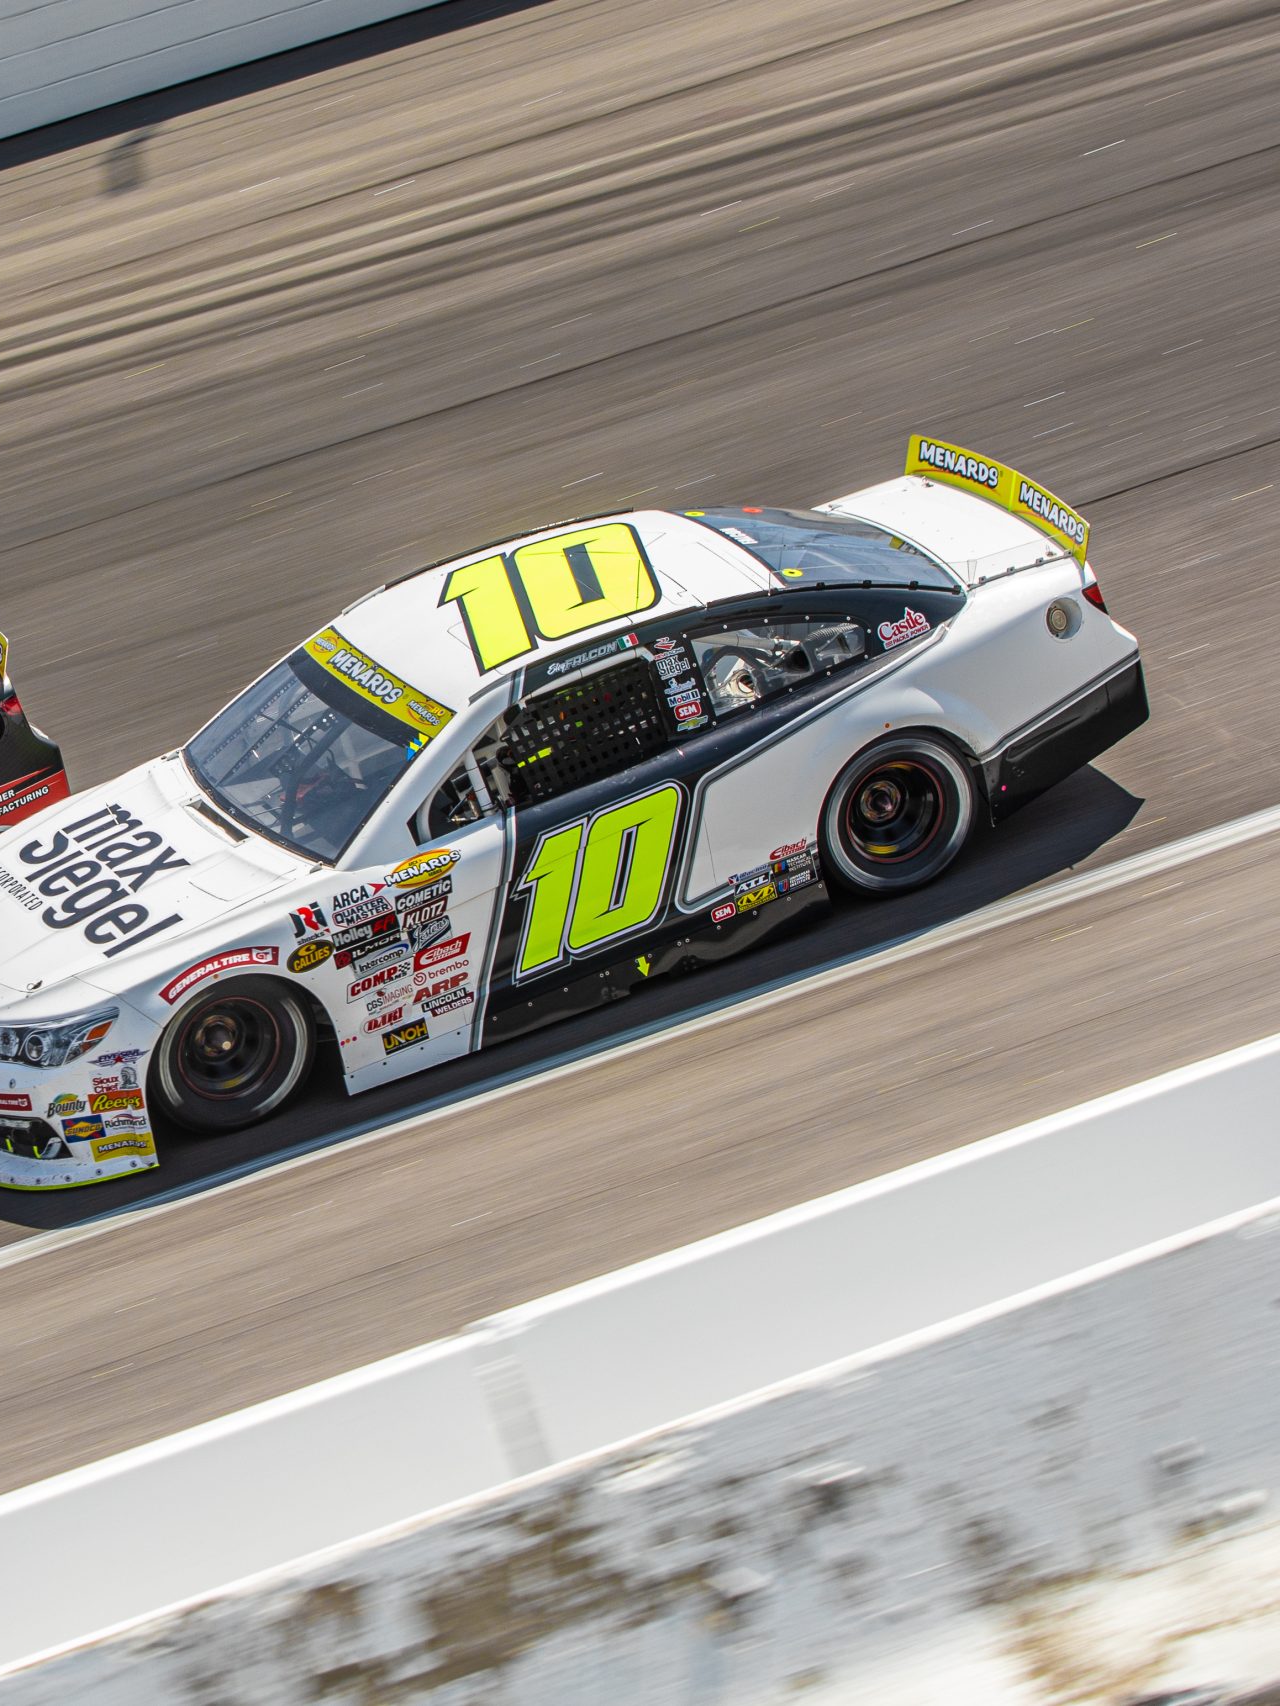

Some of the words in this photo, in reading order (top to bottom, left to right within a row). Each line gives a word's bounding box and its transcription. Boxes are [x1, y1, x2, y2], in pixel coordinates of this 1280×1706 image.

[919, 440, 999, 489] MENARDS
[1019, 480, 1086, 545] MENARDS
[438, 523, 661, 676] 10
[879, 609, 924, 641] Castle
[327, 648, 404, 704] MENARDS
[407, 700, 441, 726] MENARDS
[669, 693, 692, 707] Mobil
[679, 705, 698, 716] SEM
[62, 803, 191, 894] max
[786, 853, 807, 863] NASCAR
[384, 850, 461, 887] MENARDS
[517, 783, 682, 978] 10
[19, 831, 184, 959] Siegel
[333, 885, 370, 911] ARCA
[397, 880, 450, 911] COMETIC
[737, 875, 769, 895] ATL
[334, 898, 384, 924] QUARTER
[346, 904, 389, 926] MASTER
[406, 900, 445, 929] KLOTZ
[715, 906, 732, 919] SEM
[332, 924, 373, 947] Holley
[352, 930, 401, 958] ILMOR
[294, 946, 331, 971] CALLIES
[358, 948, 404, 972] Intercomp
[428, 960, 470, 979] brembo
[168, 961, 221, 999] GENERAL
[221, 953, 250, 967] TIRE
[351, 966, 398, 997] COMP
[413, 972, 469, 1004] ARP
[423, 988, 466, 1011] LINCOLN
[435, 997, 473, 1015] WELDERS
[383, 1022, 428, 1050] UNOH
[92, 1076, 120, 1086] Sioux
[94, 1083, 120, 1094] Chief
[47, 1099, 87, 1119] Bounty
[65, 1122, 104, 1136] SUNOCO
